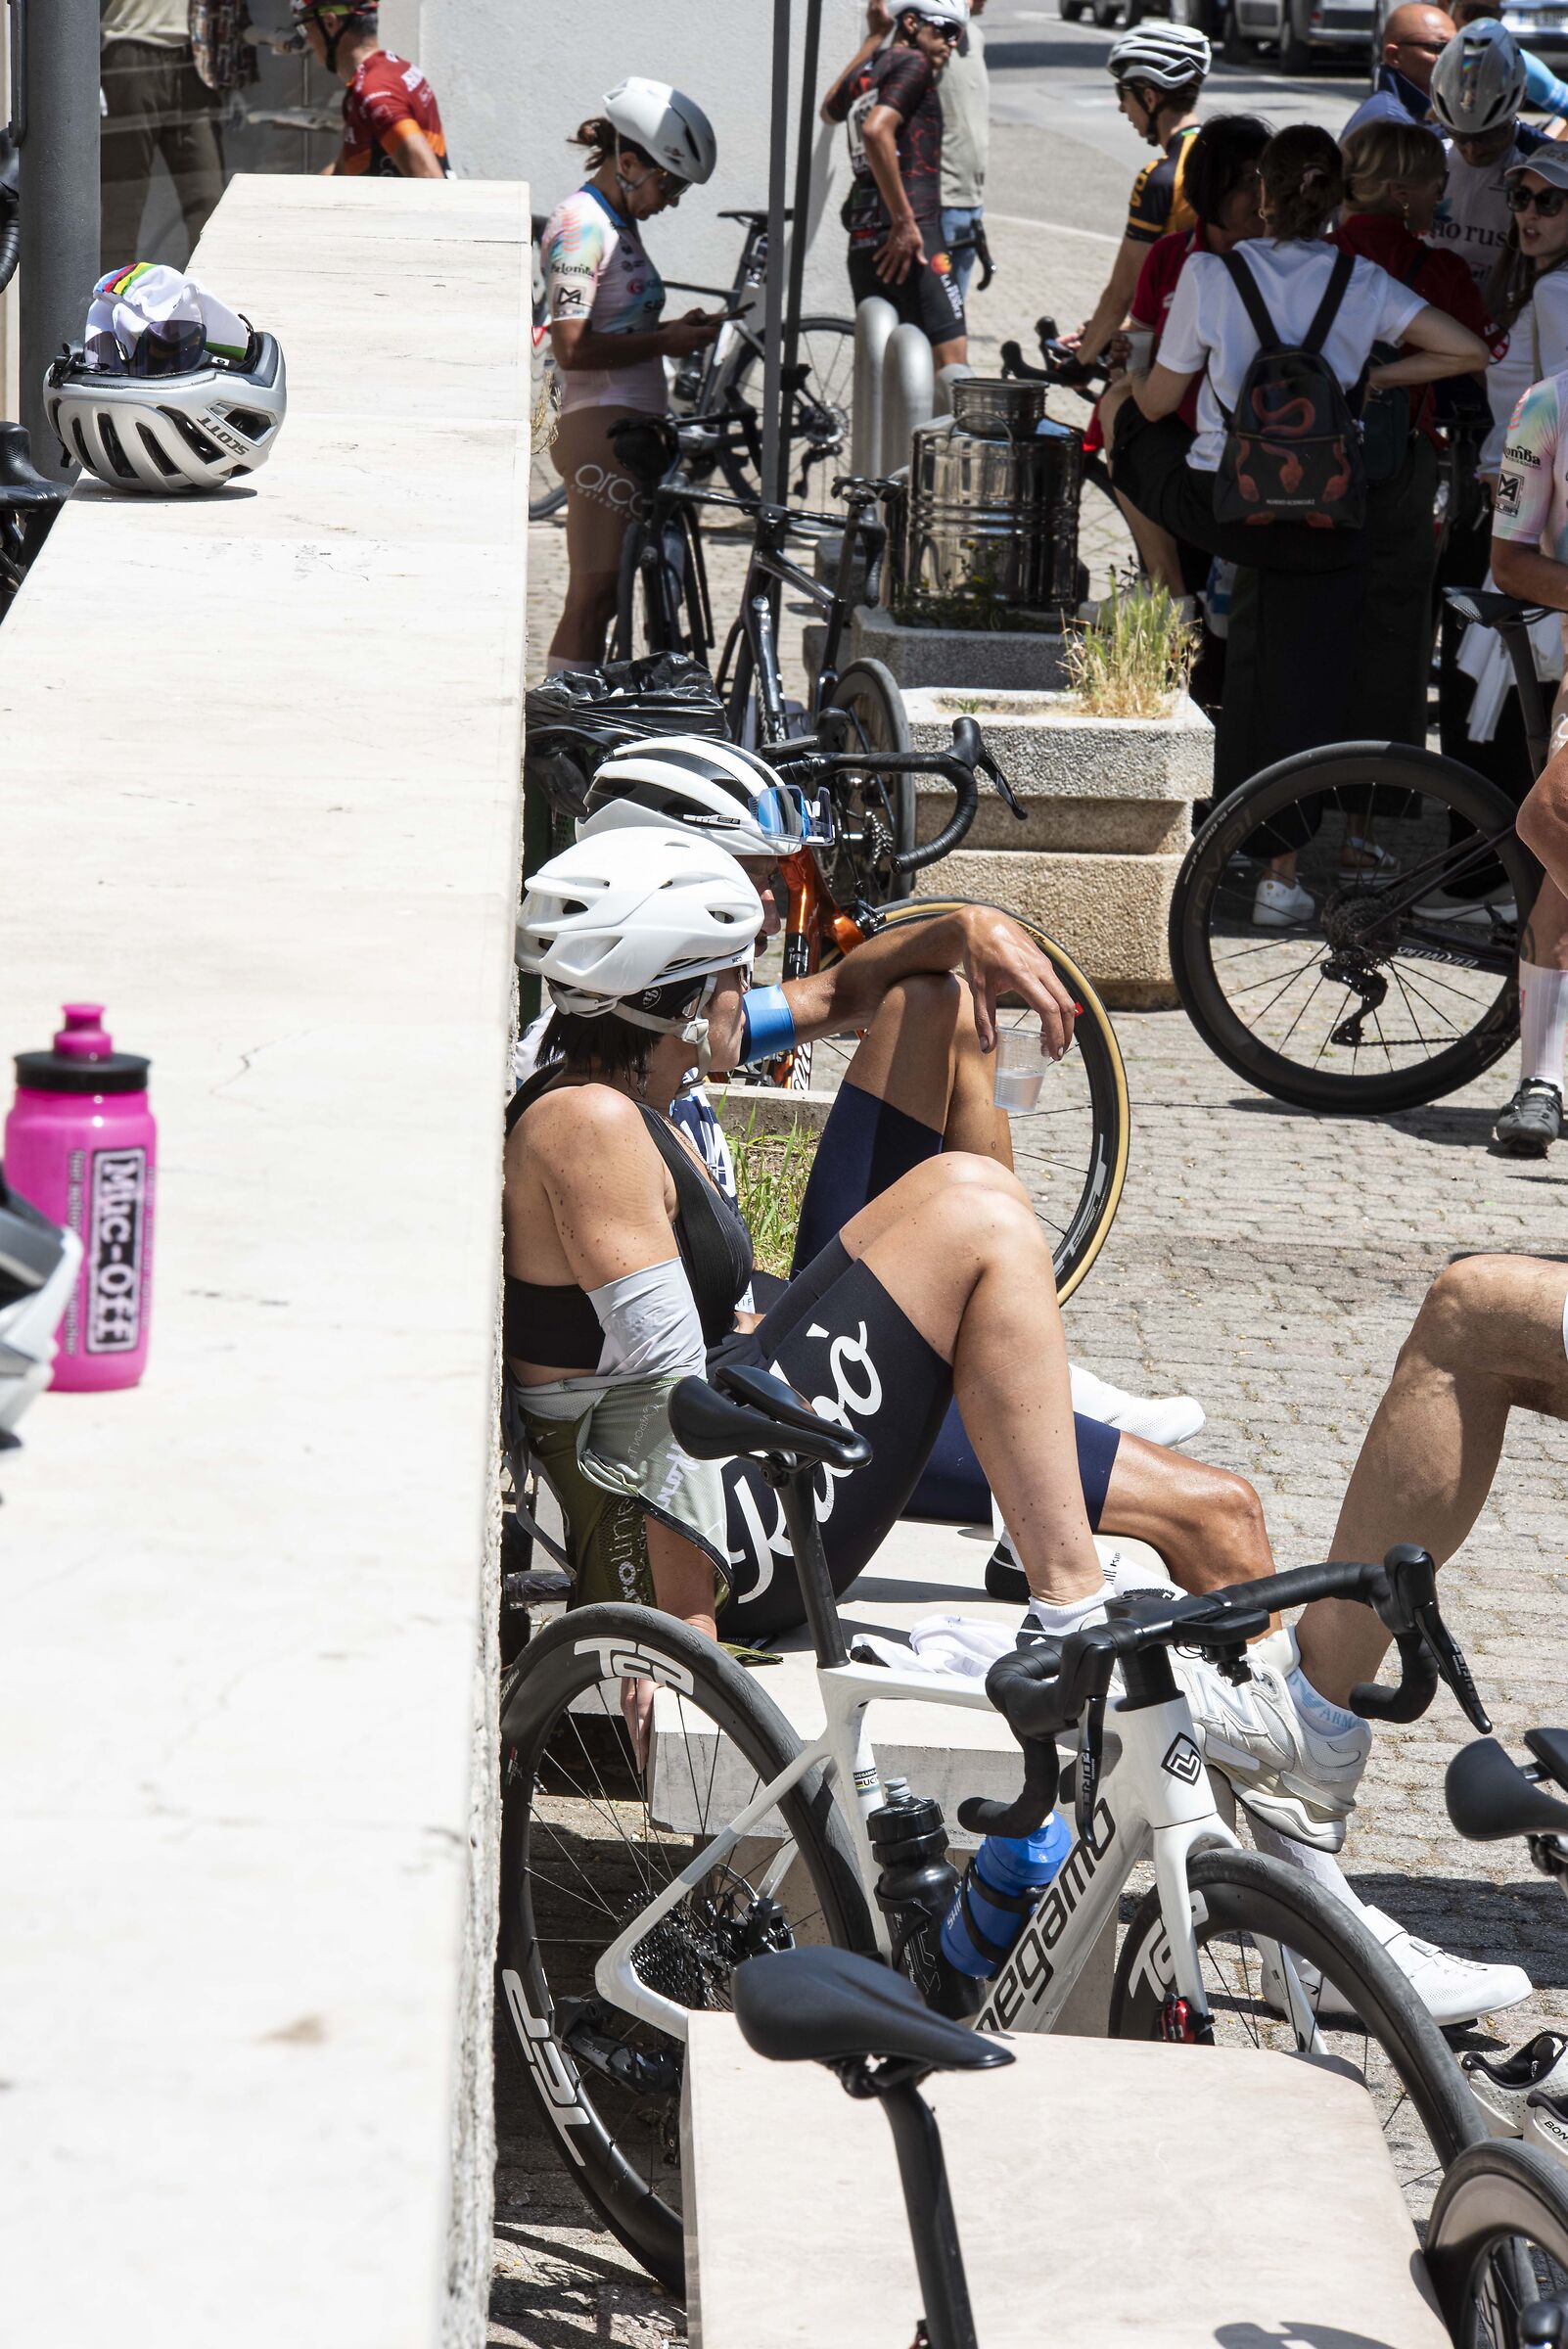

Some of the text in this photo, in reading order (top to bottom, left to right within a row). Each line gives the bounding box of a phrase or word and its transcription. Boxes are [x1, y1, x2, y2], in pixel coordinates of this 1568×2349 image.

[196, 417, 250, 456] SCOTT
[1396, 944, 1480, 969] SPECIALIZED
[98, 1159, 138, 1344] Muc-Off
